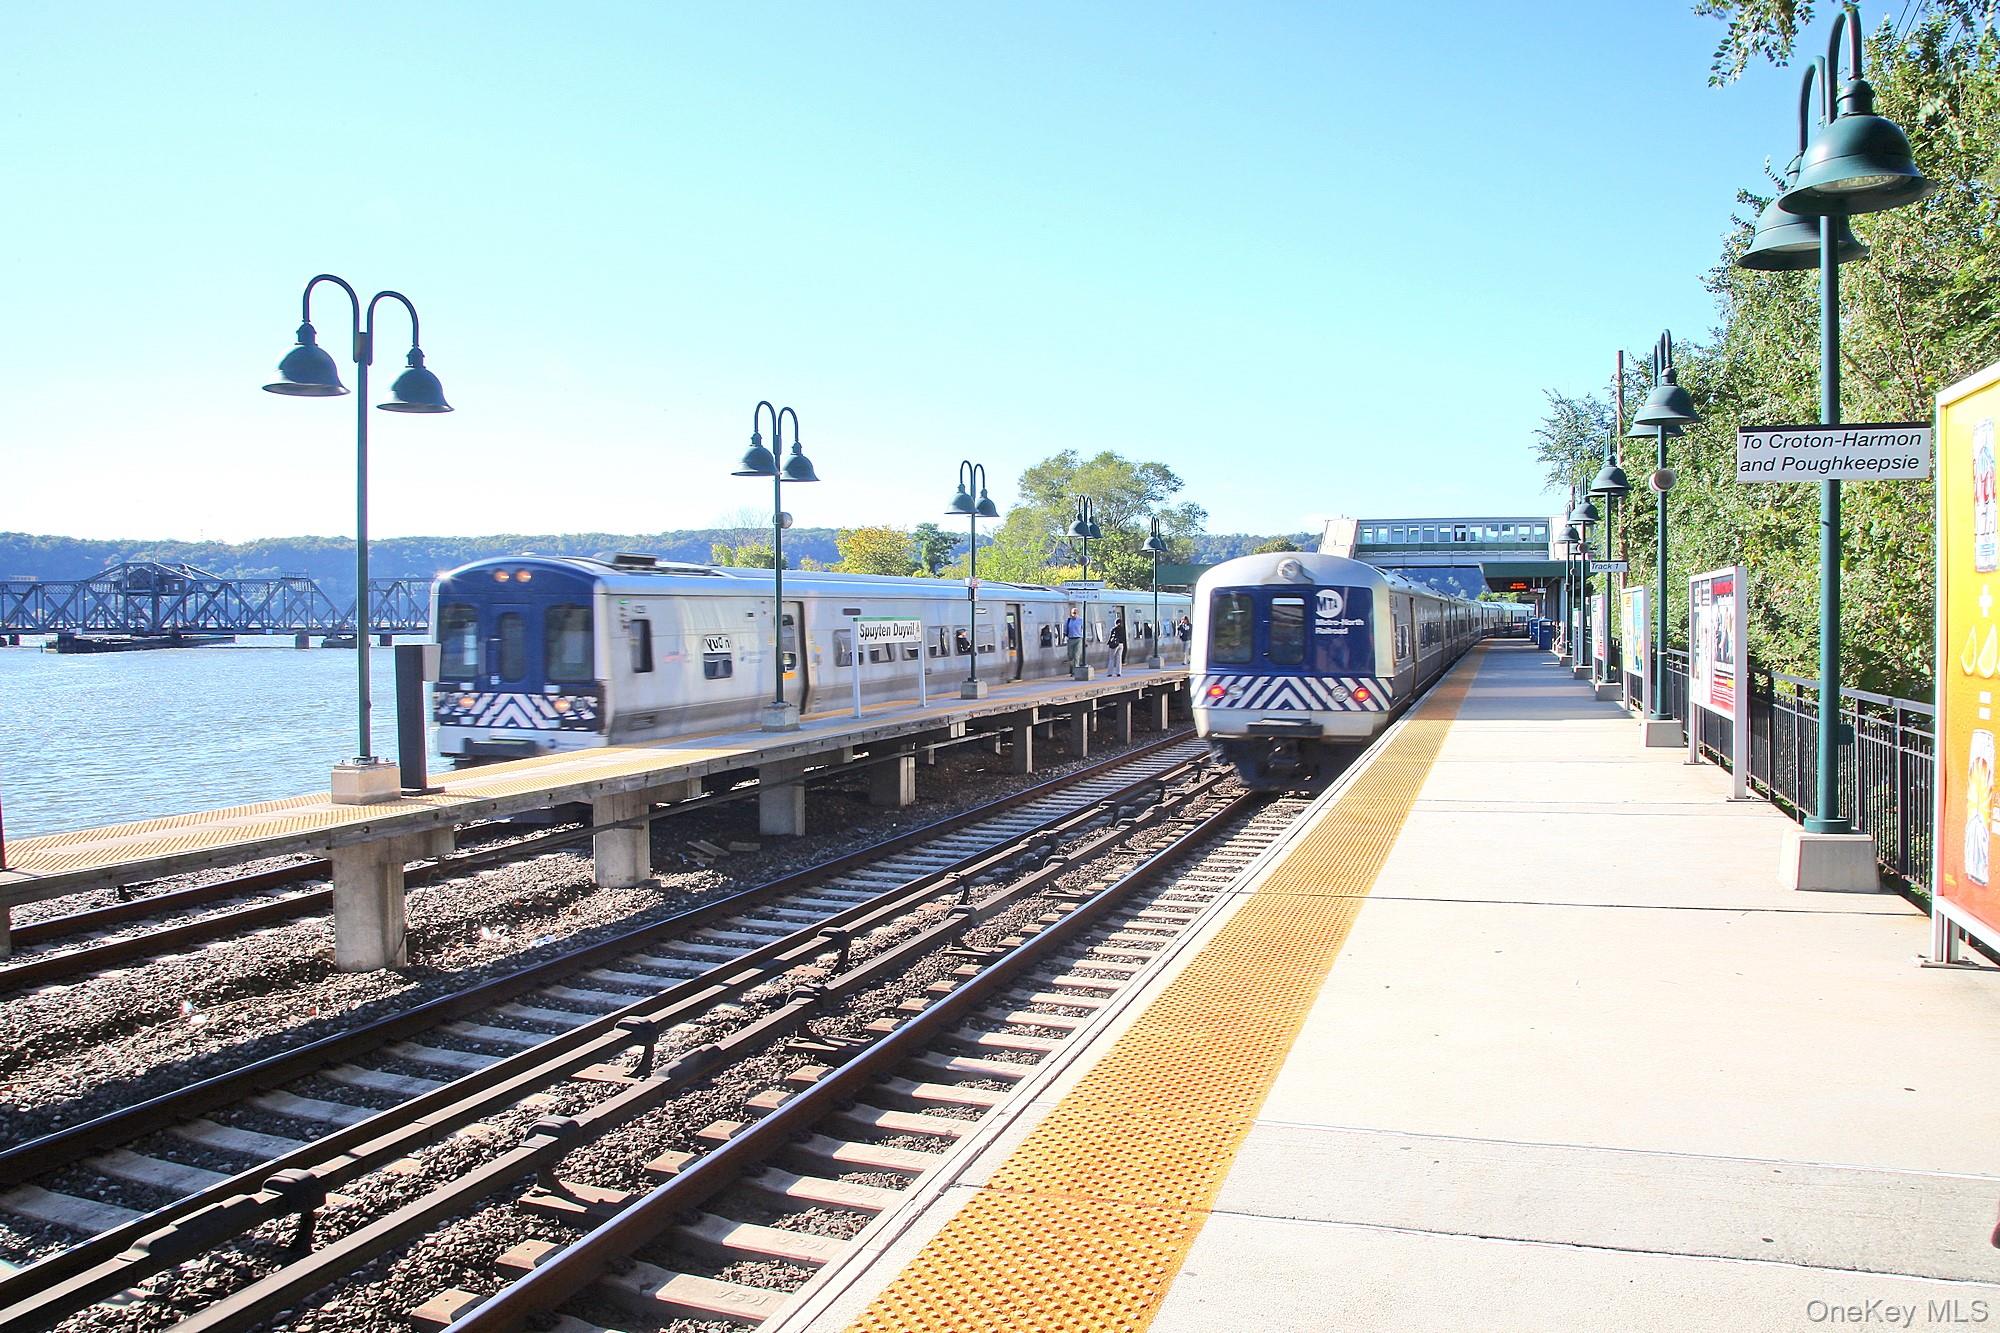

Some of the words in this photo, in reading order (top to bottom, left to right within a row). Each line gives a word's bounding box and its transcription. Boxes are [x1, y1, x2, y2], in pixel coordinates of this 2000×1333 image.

[1742, 434, 1762, 450] To
[1769, 431, 1922, 449] Croton-Harmon
[1740, 456, 1776, 472] and
[1781, 454, 1920, 474] Poughkeepsie
[1591, 562, 1612, 570] Track
[1317, 596, 1338, 611] MTA
[859, 623, 891, 640] Spuyten
[893, 622, 915, 639] Duyvil
